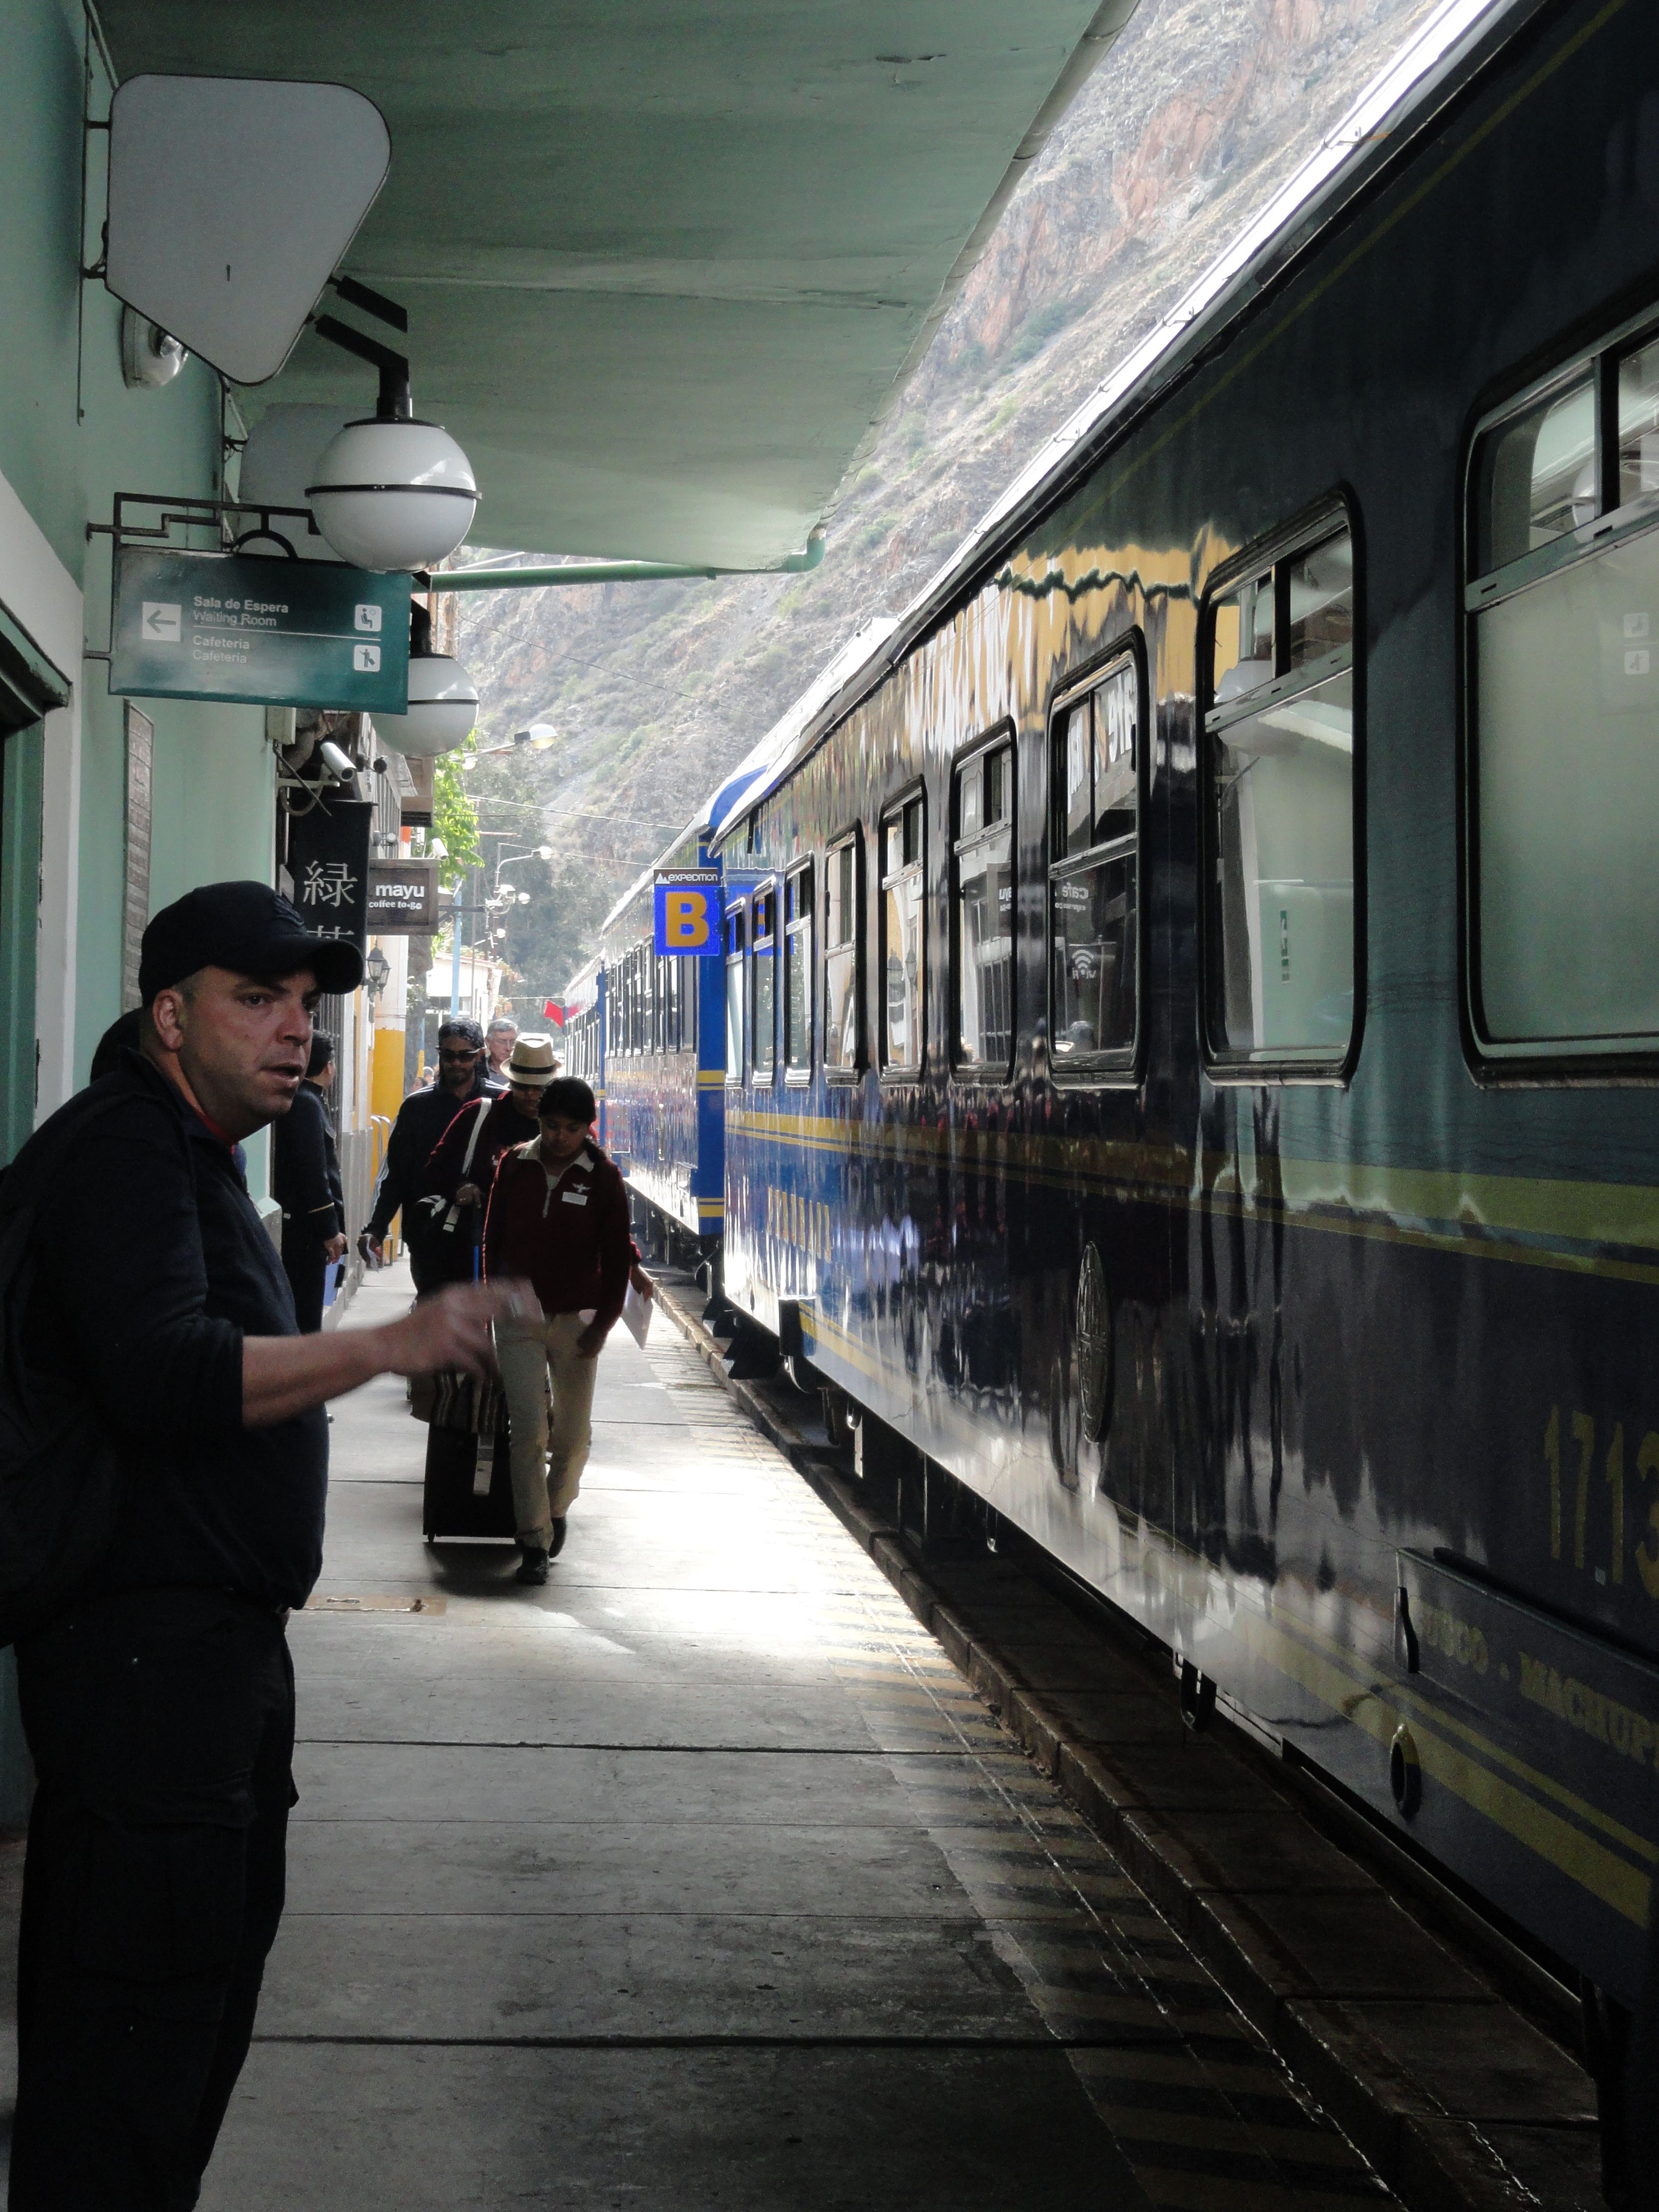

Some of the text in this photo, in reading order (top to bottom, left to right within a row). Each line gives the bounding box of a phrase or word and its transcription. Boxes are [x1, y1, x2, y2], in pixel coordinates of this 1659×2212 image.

[194, 596, 289, 614] Sala de Espera
[193, 610, 276, 626] Waiting Room
[193, 635, 250, 649] Cafeteria
[376, 884, 424, 900] mayu
[369, 900, 395, 909] coffee
[666, 892, 710, 947] B
